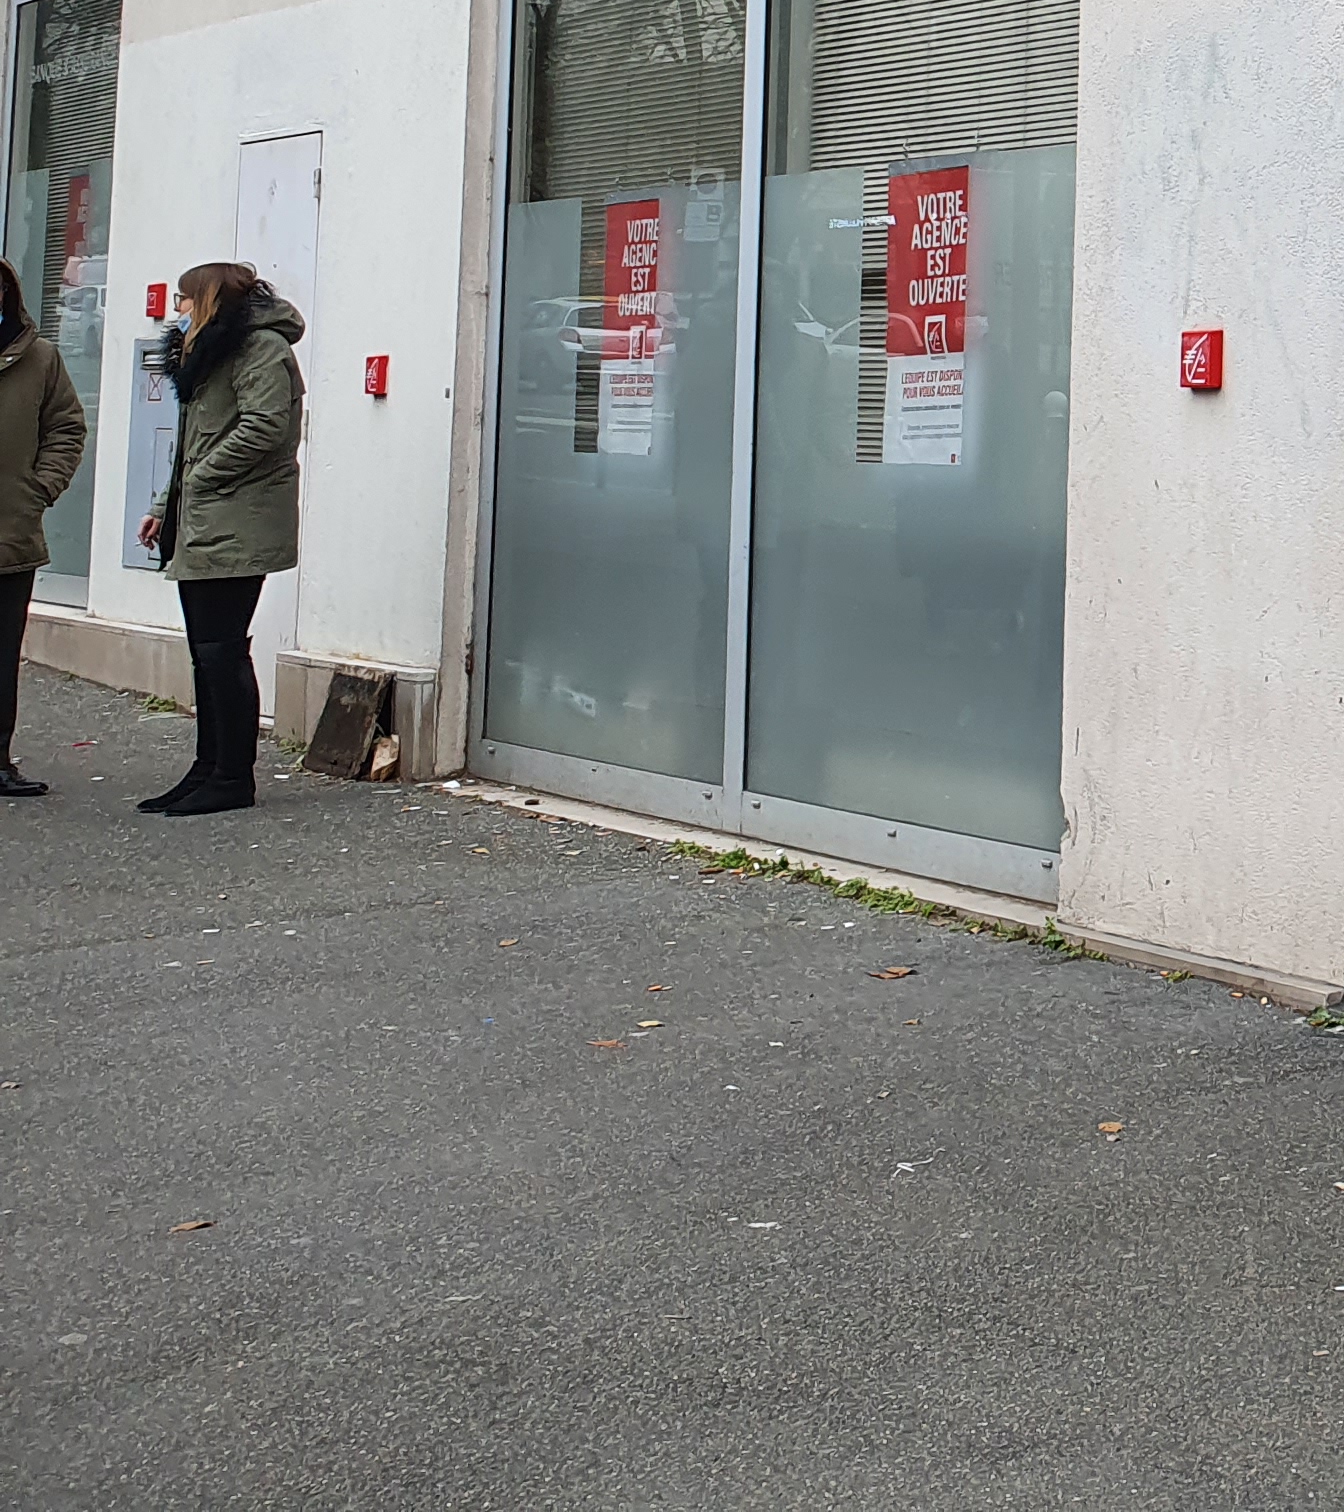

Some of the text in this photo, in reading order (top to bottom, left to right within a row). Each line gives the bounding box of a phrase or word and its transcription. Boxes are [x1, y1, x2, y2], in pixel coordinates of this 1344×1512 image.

[917, 190, 964, 220] VOTRE
[627, 218, 659, 243] VOTRE
[911, 217, 967, 250] AGENCE
[621, 243, 657, 267] AGENC
[927, 248, 951, 276] EST
[631, 268, 650, 291] EST
[909, 275, 966, 306] OUVERTE
[618, 291, 656, 317] OUVERT
